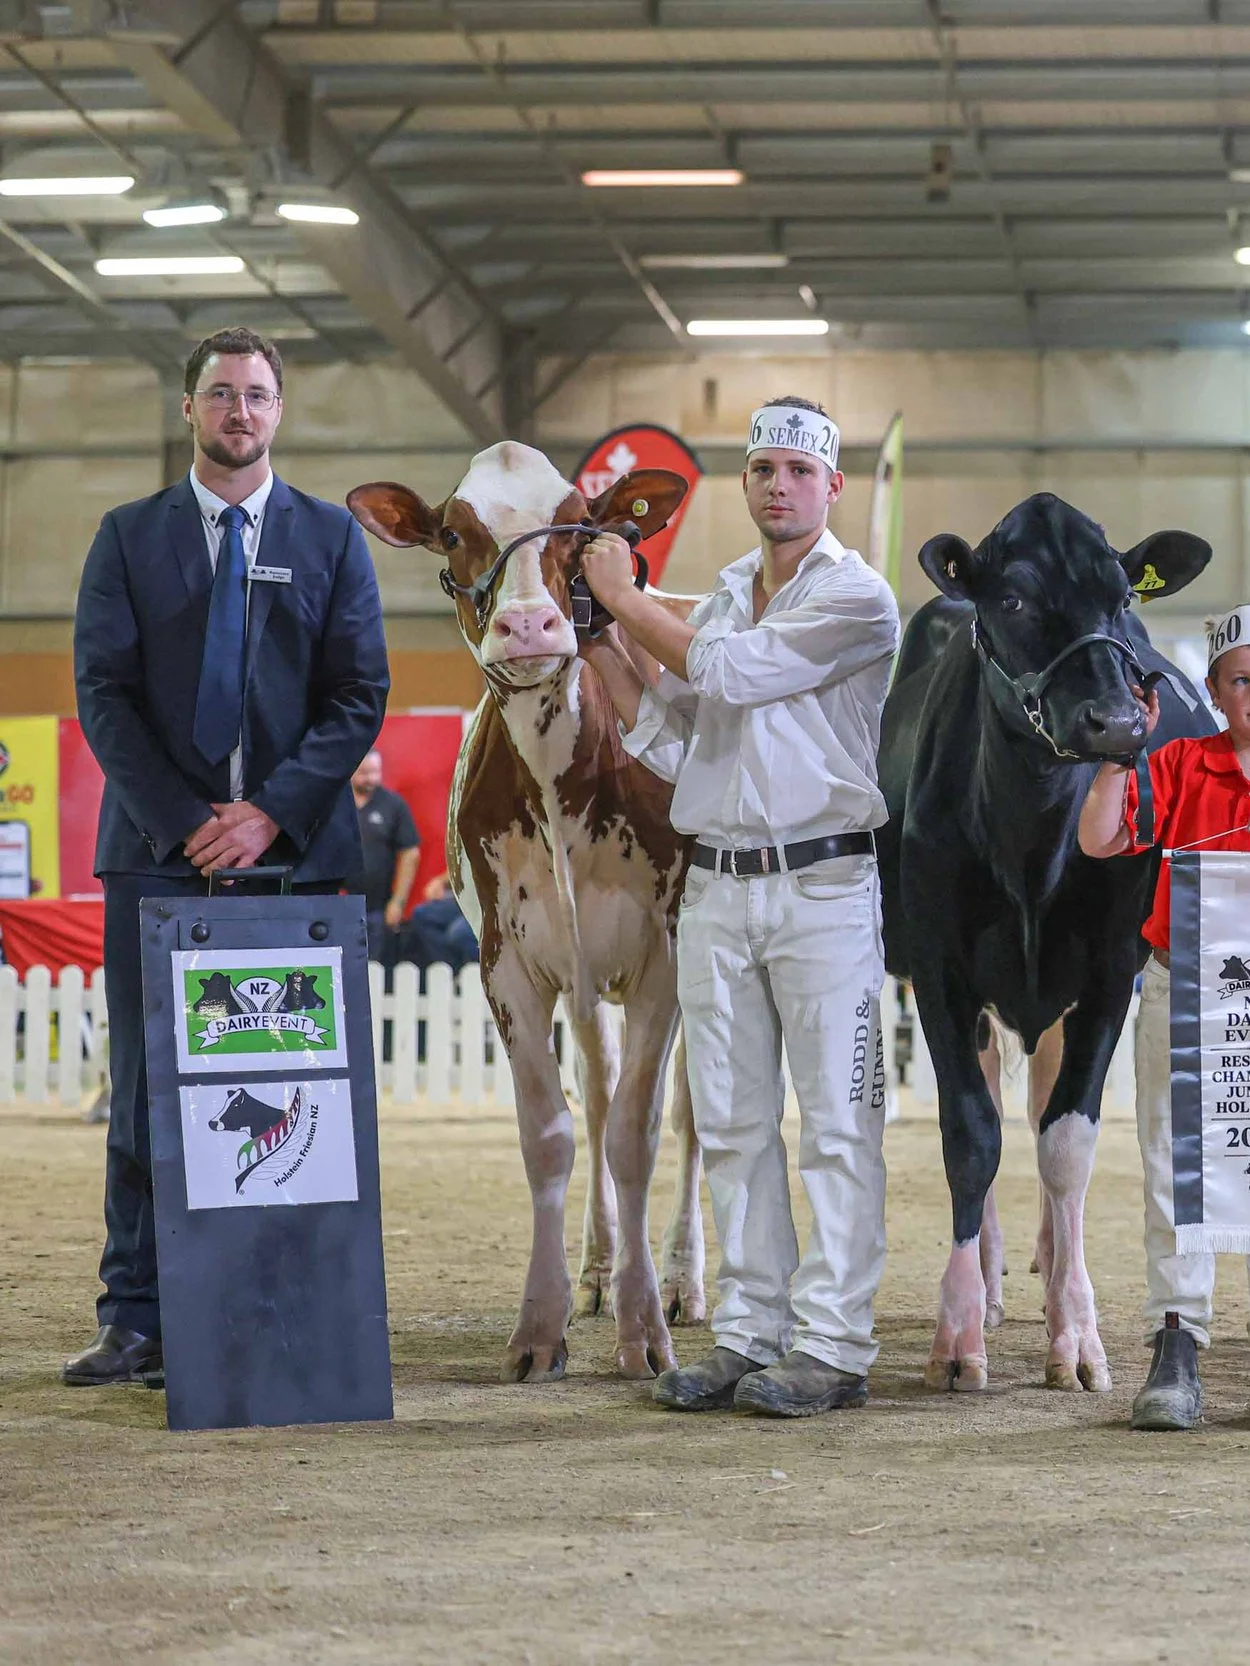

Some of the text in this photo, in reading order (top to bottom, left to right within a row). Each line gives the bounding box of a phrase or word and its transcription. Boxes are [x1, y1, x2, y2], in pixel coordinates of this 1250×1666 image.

[768, 426, 819, 453] SEMEX
[1144, 580, 1158, 589] 77
[250, 982, 270, 996] NZ
[215, 1014, 308, 1034] DAIRYEVENT
[849, 997, 870, 1104] RODD &
[871, 1028, 885, 1109] GUNN
[273, 1104, 319, 1188] Holstein Friesian NZ
